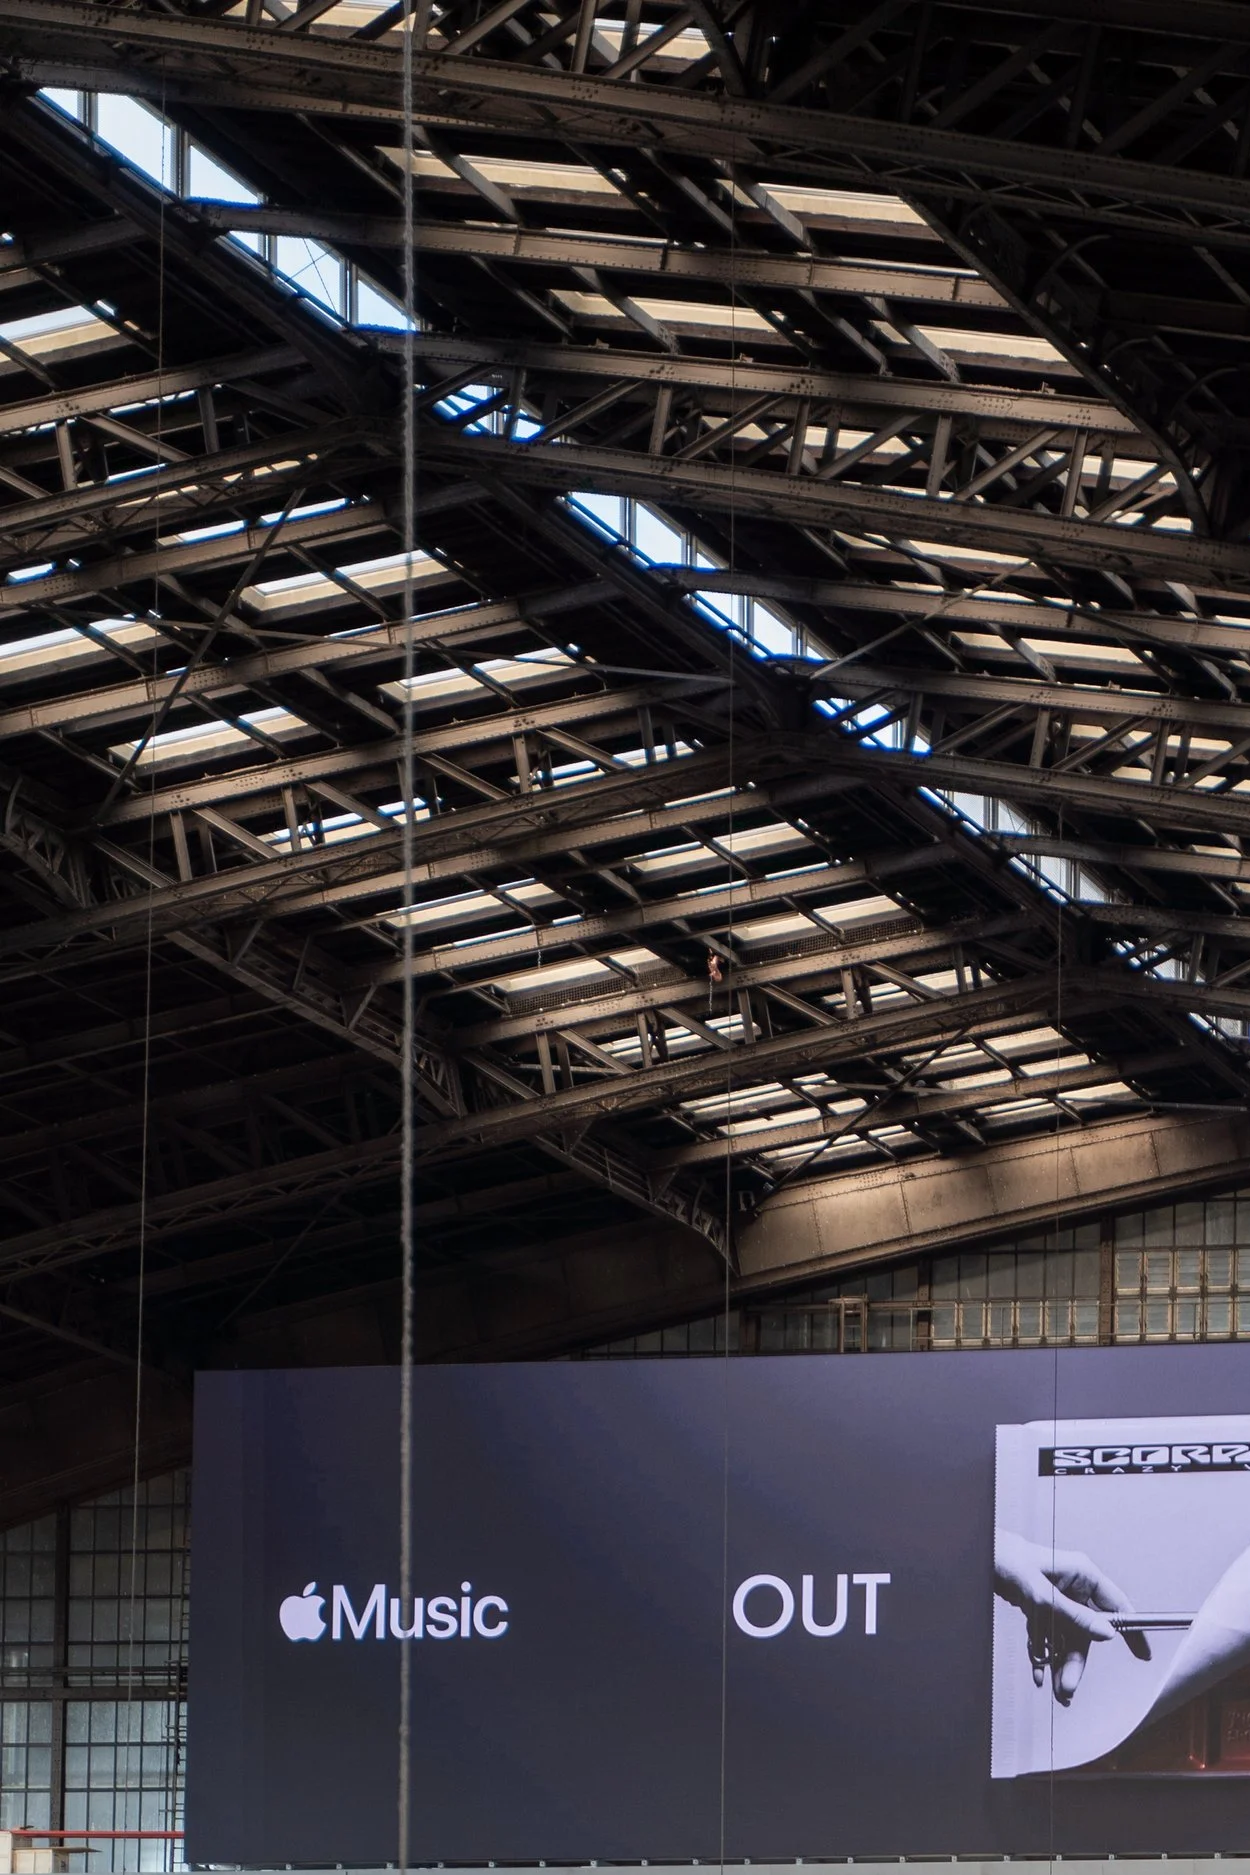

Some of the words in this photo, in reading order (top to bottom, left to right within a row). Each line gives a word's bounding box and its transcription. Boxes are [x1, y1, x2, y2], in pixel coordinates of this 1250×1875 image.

[1054, 1465, 1182, 1475] CRAZY
[331, 1581, 509, 1641] Music
[732, 1573, 892, 1639] OUT
